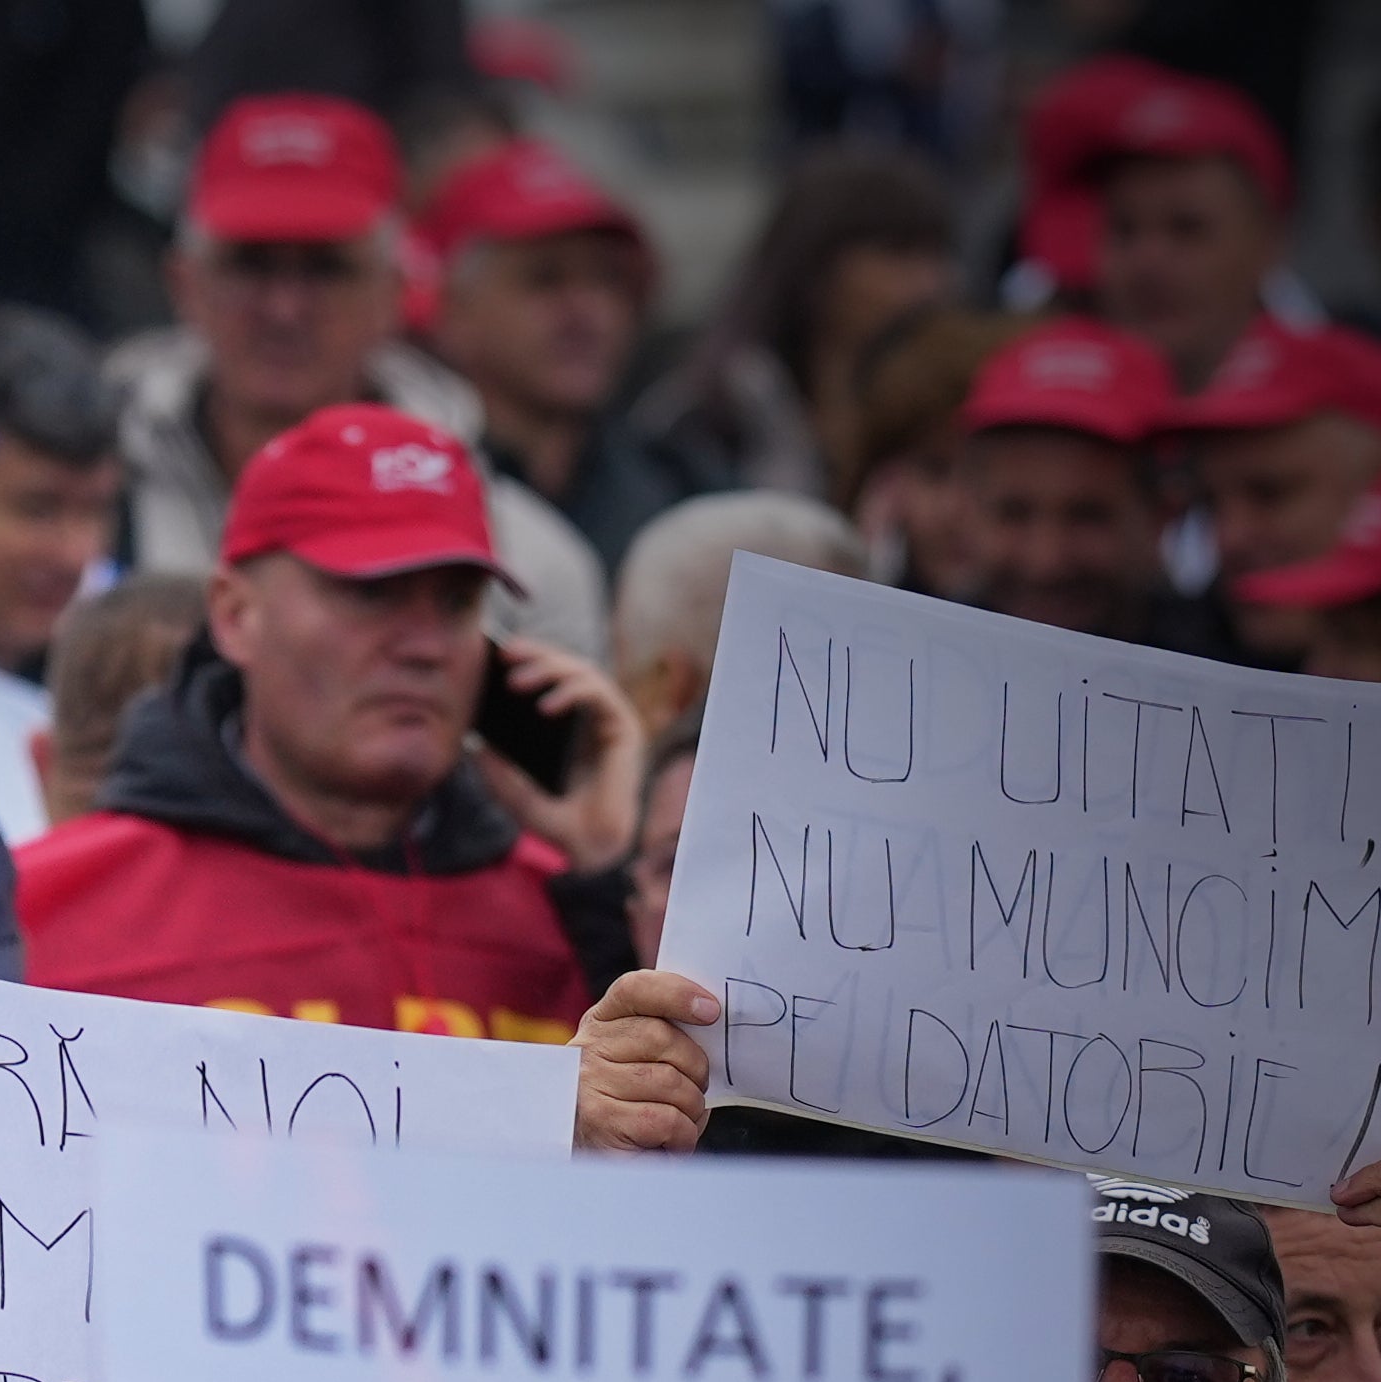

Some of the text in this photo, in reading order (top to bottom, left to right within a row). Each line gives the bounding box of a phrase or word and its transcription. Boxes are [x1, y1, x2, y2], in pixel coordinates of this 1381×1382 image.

[770, 624, 914, 784] NU
[746, 810, 1381, 1026] NU MUNCIM
[724, 976, 841, 1114] PE
